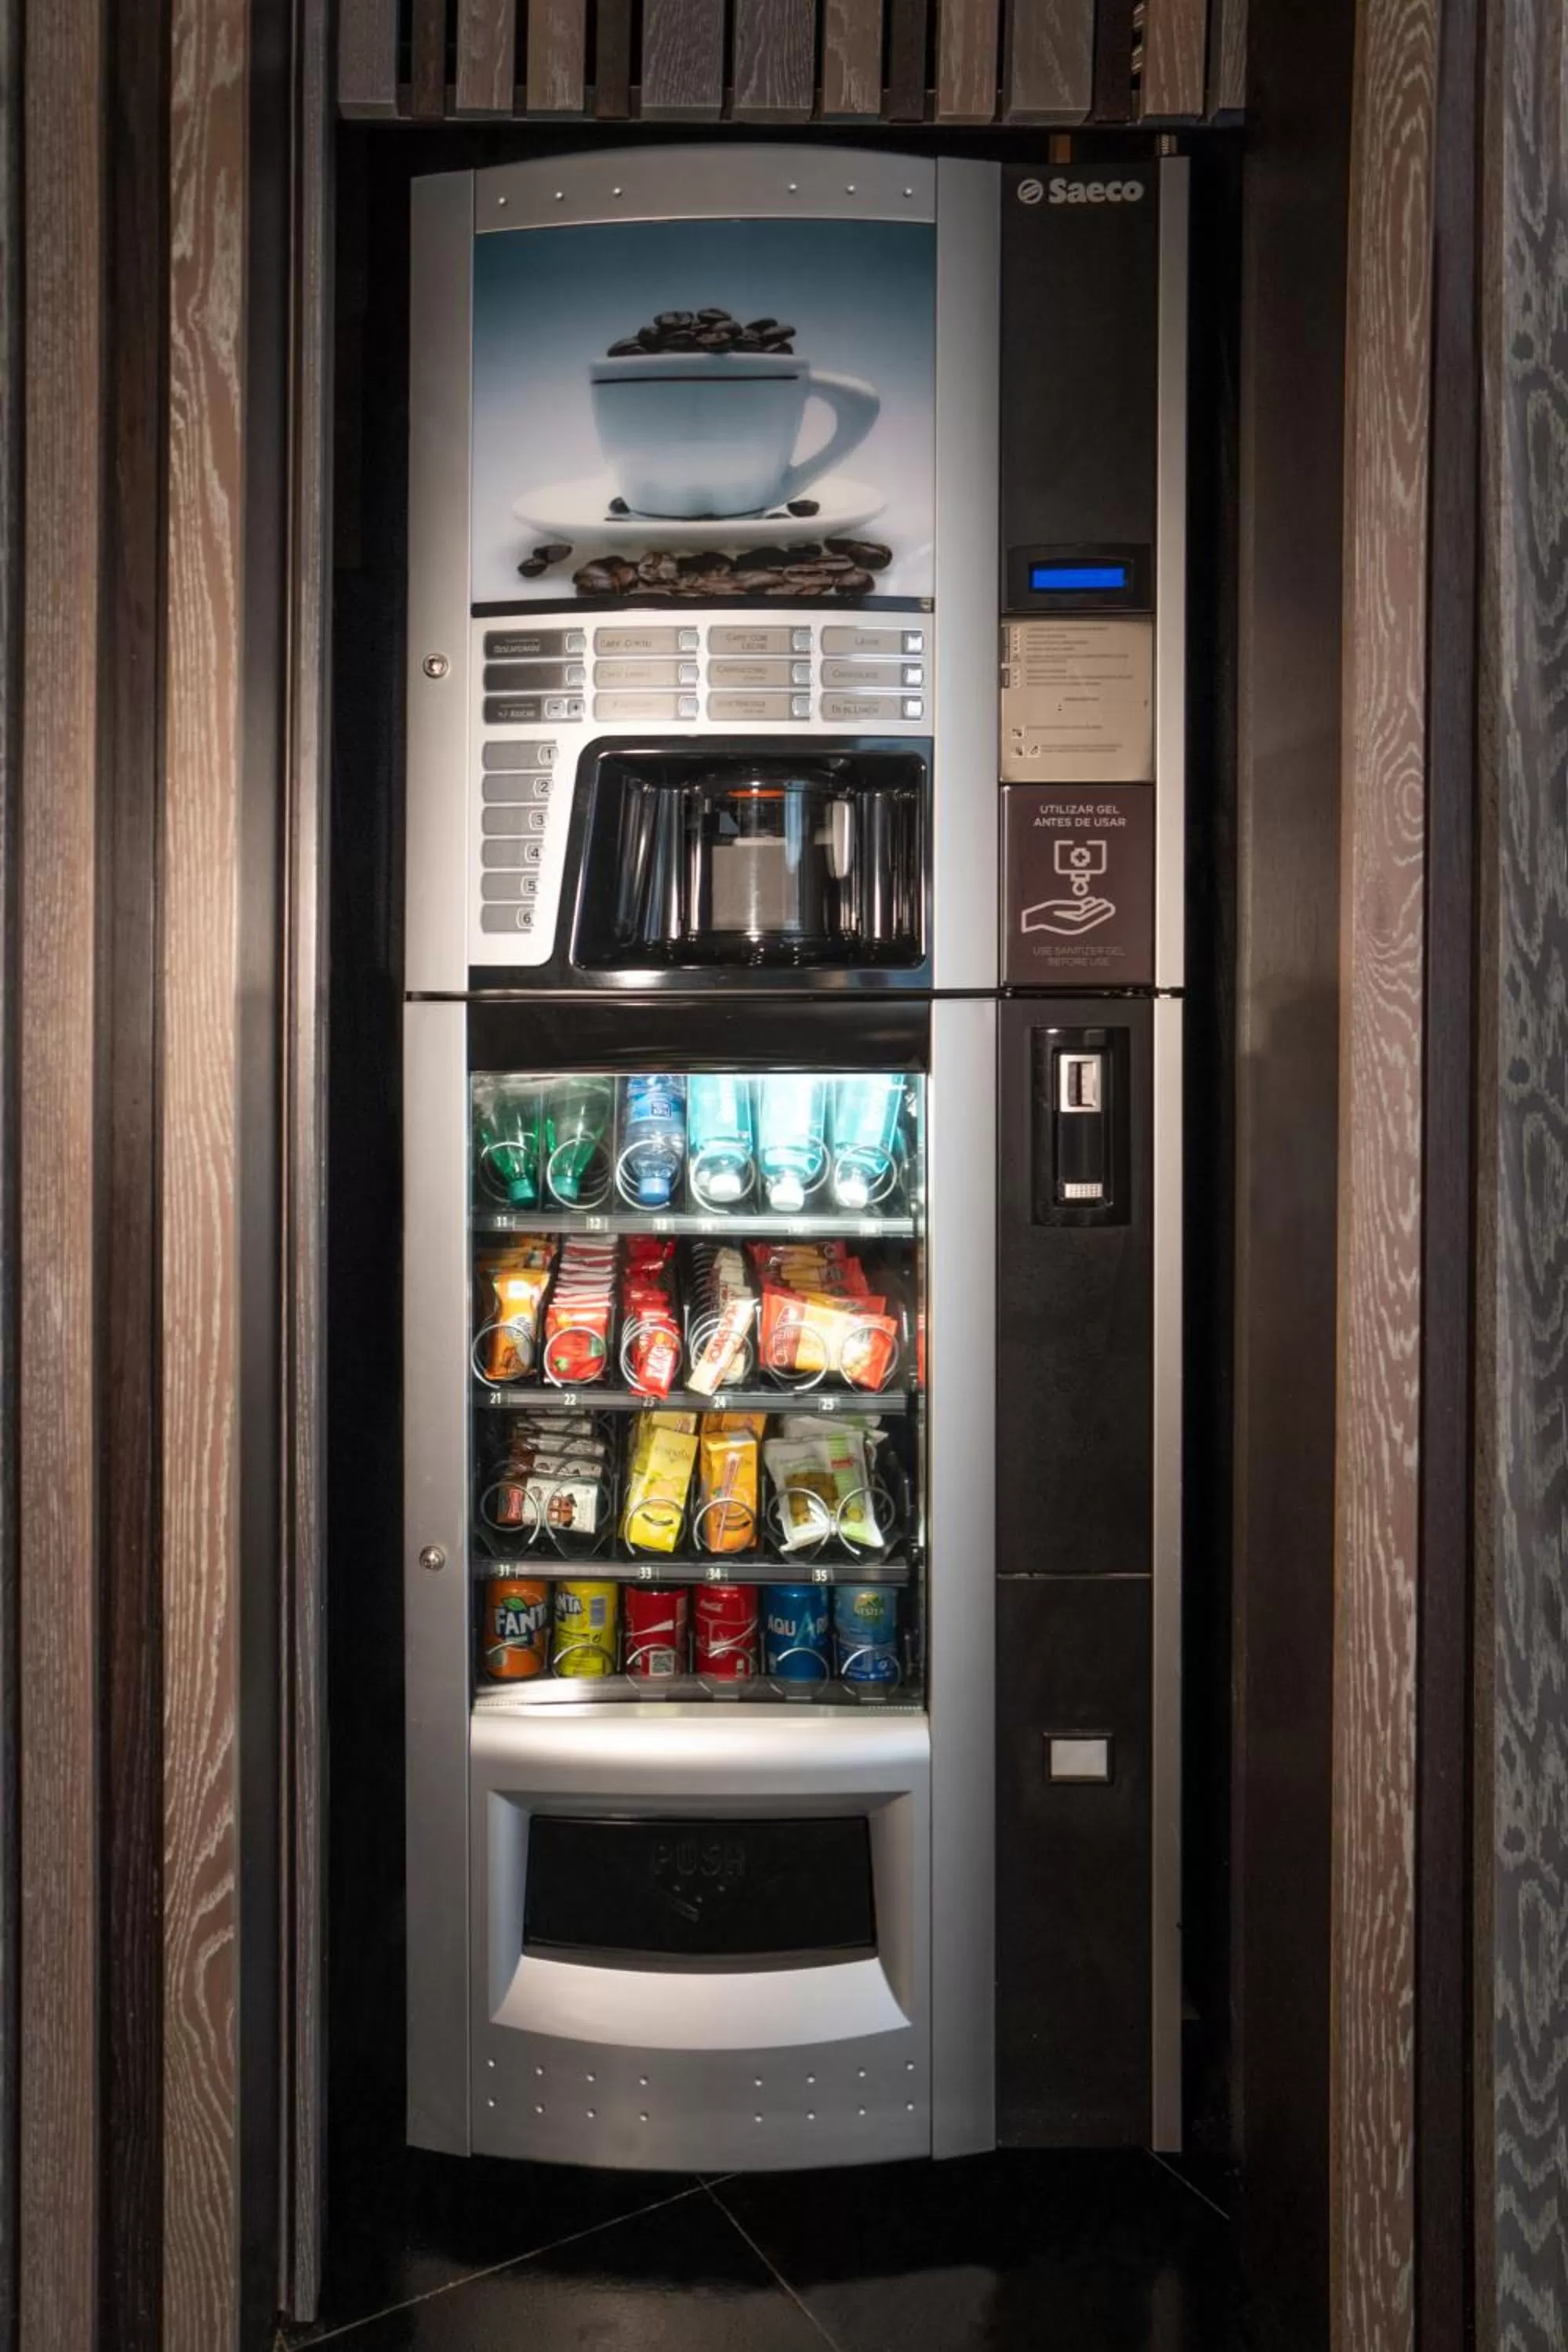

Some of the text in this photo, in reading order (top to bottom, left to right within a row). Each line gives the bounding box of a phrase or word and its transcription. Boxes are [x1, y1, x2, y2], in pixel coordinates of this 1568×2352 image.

[1048, 178, 1145, 204] Saeco
[546, 749, 552, 759] 1
[540, 782, 550, 793] 2
[1039, 804, 1120, 814] UTILIZAR GEL
[536, 815, 544, 826] 3
[1033, 818, 1127, 827] ANTES DE USAR
[530, 848, 539, 858] 4
[528, 880, 536, 891] 5
[523, 913, 532, 924] 6
[490, 1392, 501, 1404] 21
[564, 1394, 576, 1406] 22
[639, 1567, 652, 1579] 33
[708, 1568, 720, 1581] 34
[815, 1570, 827, 1581] 35
[652, 1838, 746, 1876] PUSH
